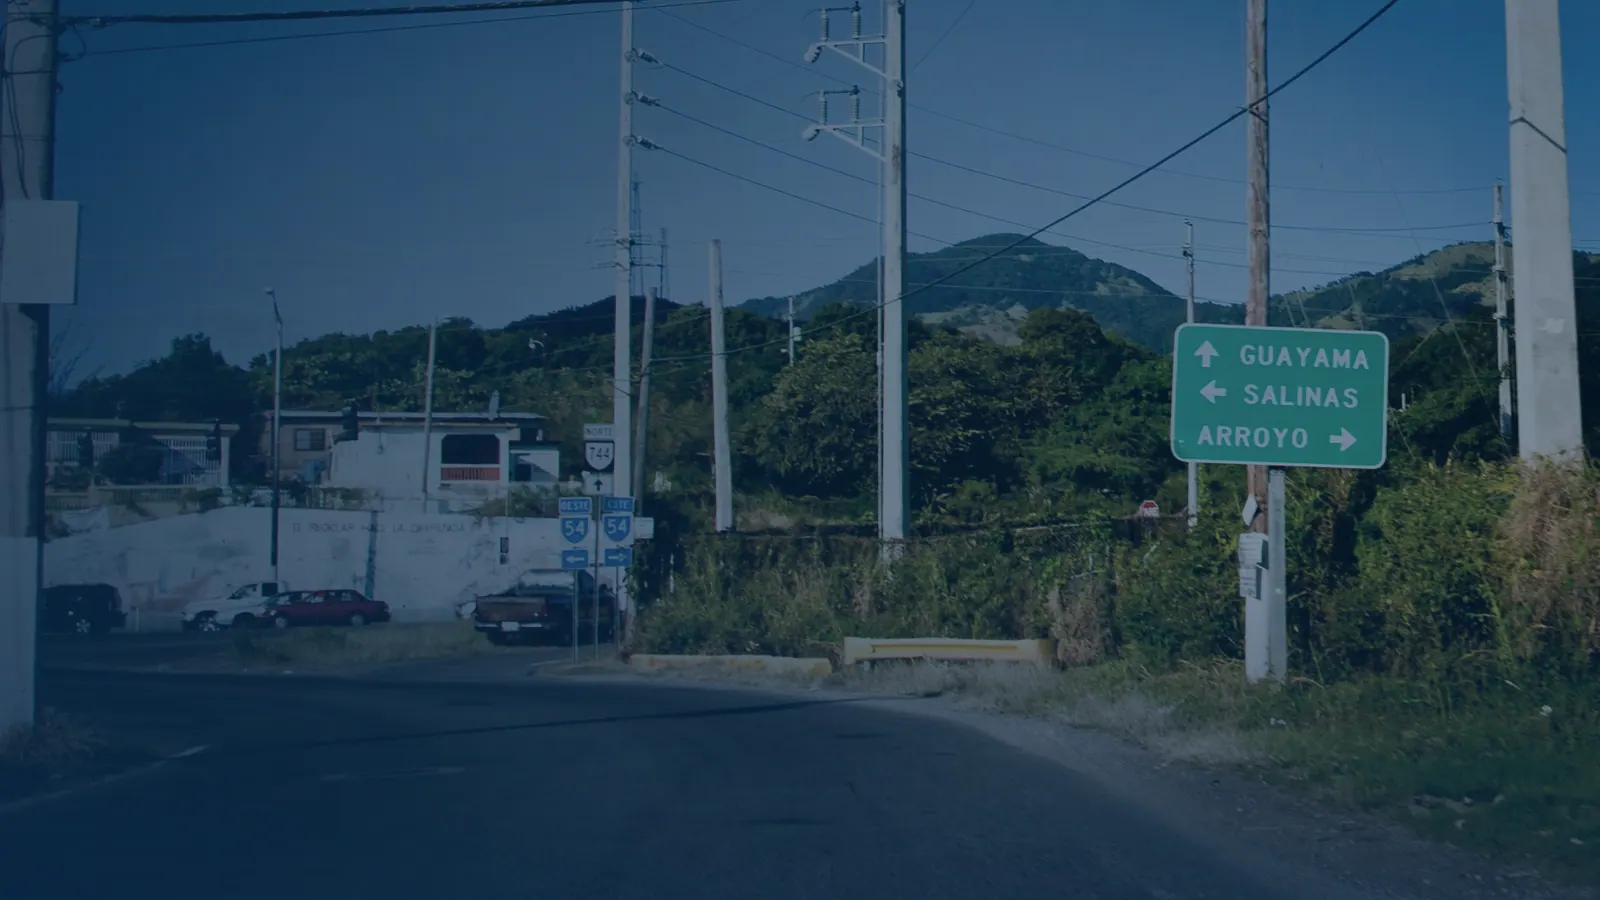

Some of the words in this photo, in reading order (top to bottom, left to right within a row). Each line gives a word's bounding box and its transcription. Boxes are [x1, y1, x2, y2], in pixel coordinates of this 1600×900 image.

[1239, 344, 1369, 370] GUAYAMA
[1243, 383, 1359, 409] SALINAS
[585, 427, 613, 437] NORTE
[1197, 425, 1308, 449] ARROYO
[589, 446, 610, 461] 744
[561, 499, 589, 511] OESTE
[607, 499, 629, 510] ESTE
[564, 520, 585, 537] 54
[607, 515, 627, 534] 54
